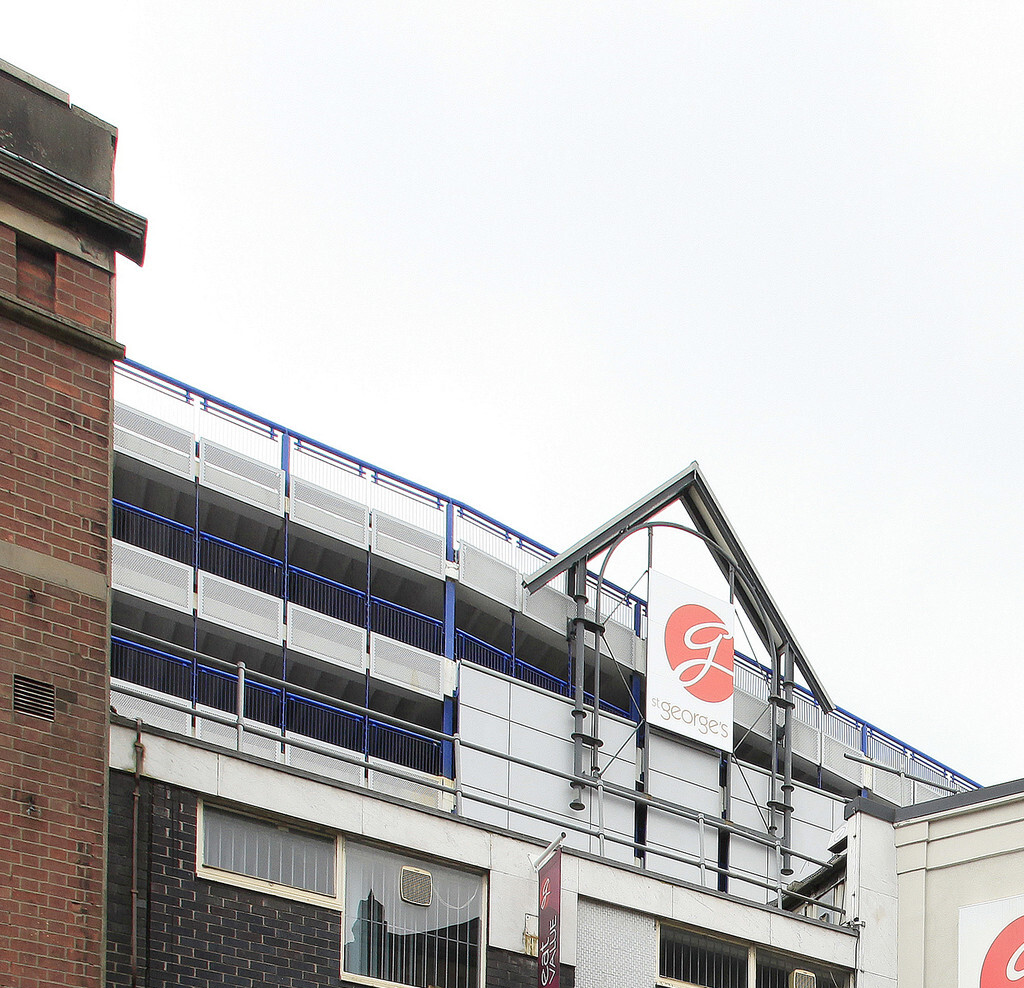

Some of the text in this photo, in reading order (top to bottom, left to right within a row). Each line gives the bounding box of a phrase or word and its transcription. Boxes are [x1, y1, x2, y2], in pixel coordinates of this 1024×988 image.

[651, 697, 729, 738] st george's
[548, 915, 558, 984] VALUE
